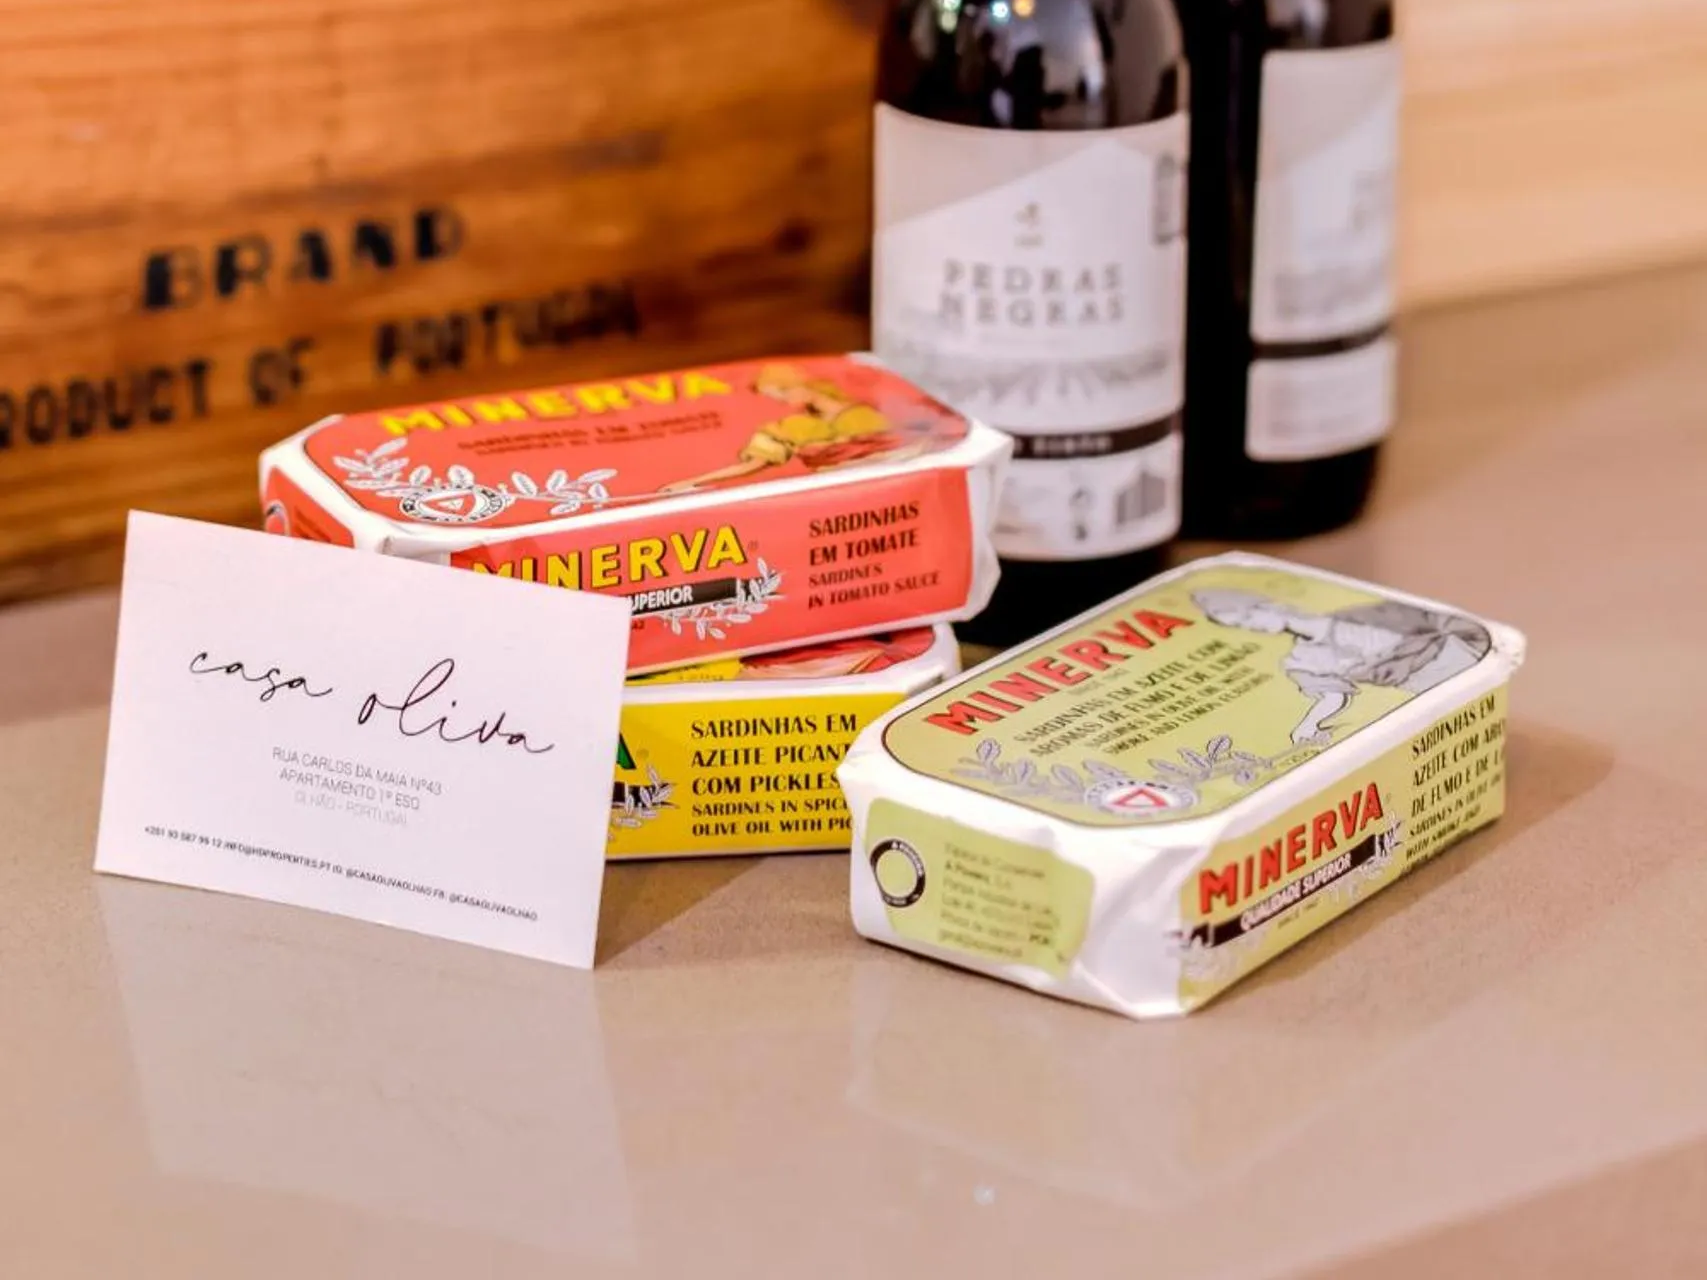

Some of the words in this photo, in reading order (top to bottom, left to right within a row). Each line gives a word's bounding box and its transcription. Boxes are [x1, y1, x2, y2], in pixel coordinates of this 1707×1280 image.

[144, 207, 466, 311] BRAND
[944, 258, 1122, 294] PEDRAS
[940, 291, 1124, 328] NEGRAS
[248, 334, 314, 408] OF
[378, 372, 732, 436] MINERVA
[809, 500, 920, 538] SARDINHAS
[809, 545, 838, 566] EM
[845, 527, 920, 560] TOMATE
[808, 563, 883, 588] SARDINES
[808, 594, 823, 610] IN
[830, 581, 890, 605] TOMATO
[894, 571, 940, 593] SAUCE
[631, 584, 694, 614] UPERIOR
[925, 609, 1196, 735] MINERVA
[189, 651, 333, 701] casa
[358, 658, 555, 754] oliva
[691, 715, 817, 739] SARDINHAS
[827, 714, 857, 733] EM
[1412, 706, 1477, 761] SARDINHAS
[1480, 693, 1495, 720] EM
[272, 746, 299, 764] RUA
[301, 752, 352, 776] CARLOS
[355, 764, 373, 780] DA
[376, 769, 408, 788] MAIA
[691, 747, 766, 768] AZEITE
[775, 743, 851, 764] PICANT
[1412, 749, 1447, 787] AZEITE
[1453, 733, 1480, 763] COM
[279, 767, 376, 801] APARTAMENTO
[692, 777, 741, 796] COM
[1411, 790, 1426, 818] DE
[1431, 771, 1463, 806] FUMO
[692, 800, 775, 817] SARDINES
[781, 799, 798, 813] IN
[692, 820, 740, 837] OLIVE
[746, 820, 771, 834] OIL
[779, 818, 822, 833] WITH
[828, 816, 853, 830] PIC
[1199, 782, 1384, 914] MINERVA
[1302, 852, 1352, 895] SUPERIOR
